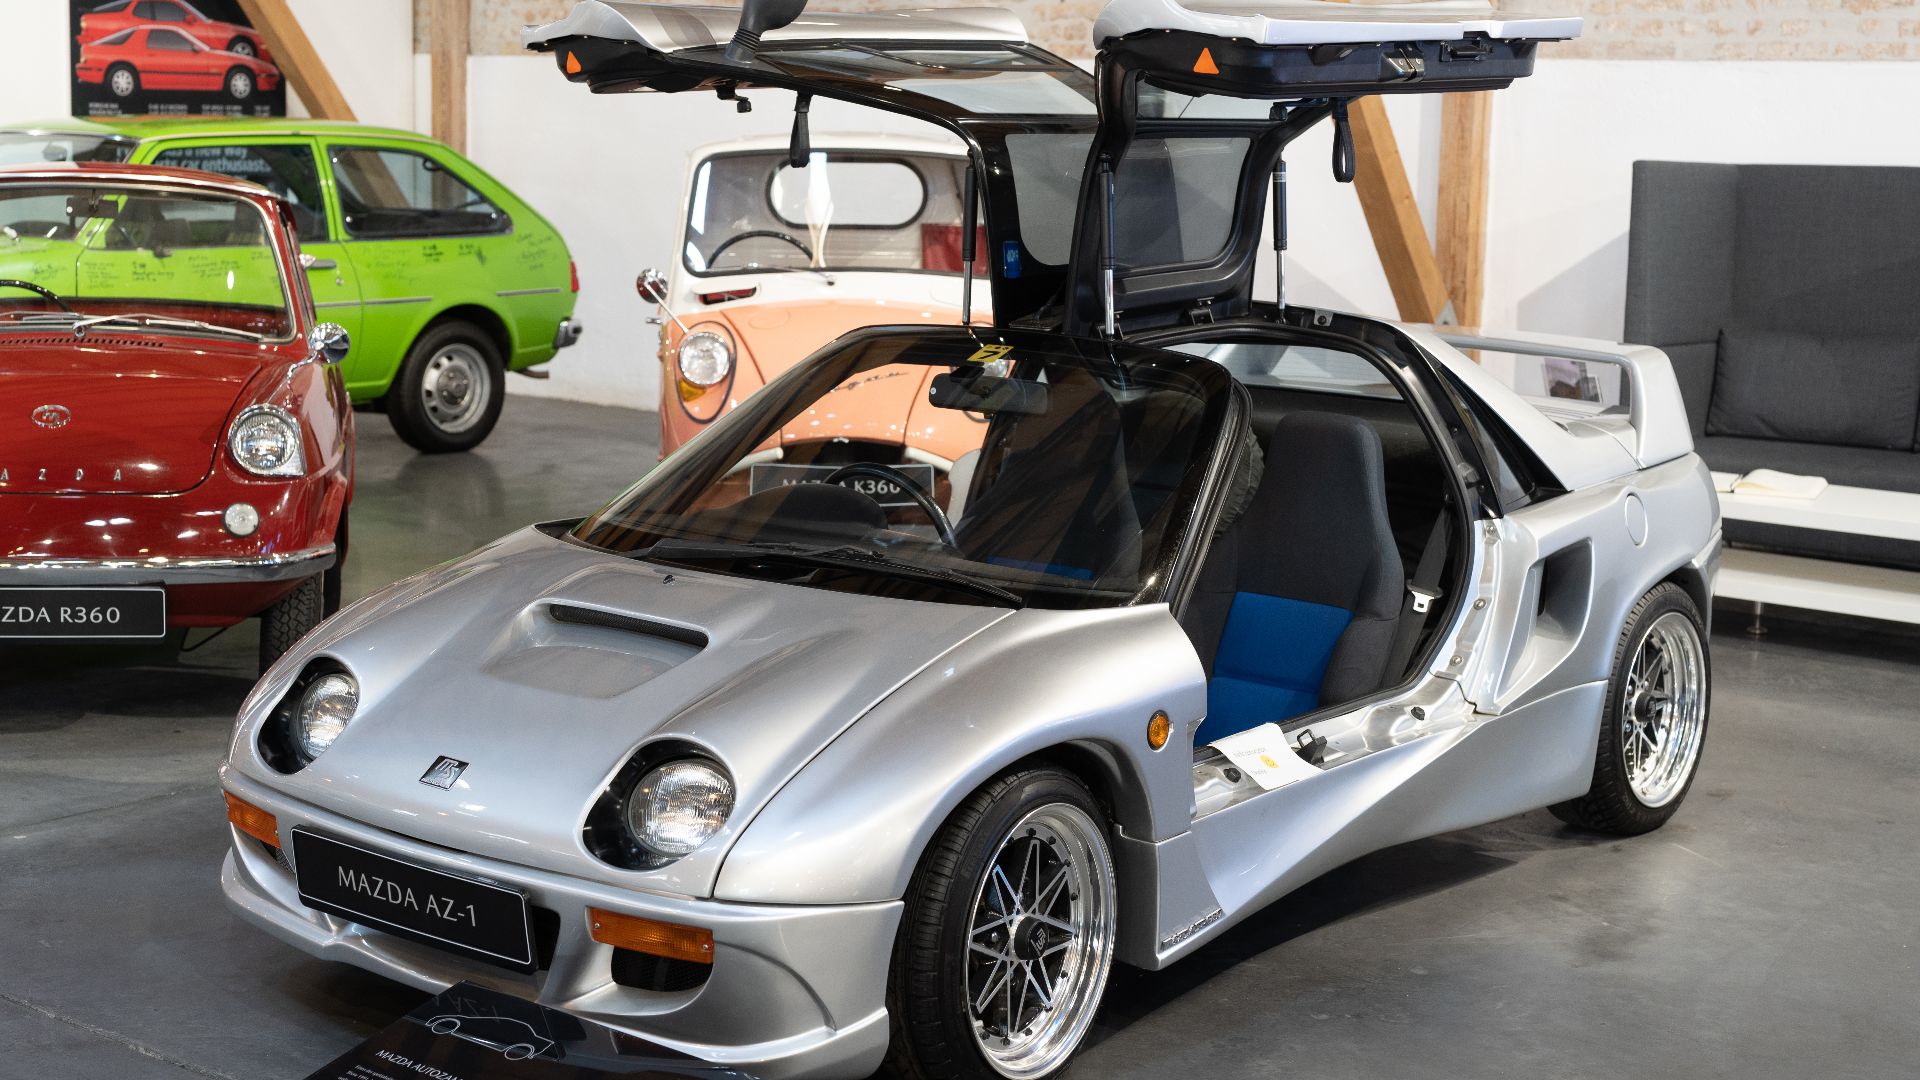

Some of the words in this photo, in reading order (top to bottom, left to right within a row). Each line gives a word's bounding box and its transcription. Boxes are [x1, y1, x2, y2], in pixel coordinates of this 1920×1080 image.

[854, 479, 900, 495] K360
[1, 606, 51, 623] ZDA
[60, 606, 120, 623] R360
[338, 865, 418, 911] MAZDA
[426, 894, 476, 927] AZ-1
[375, 1049, 414, 1069] MAZDA
